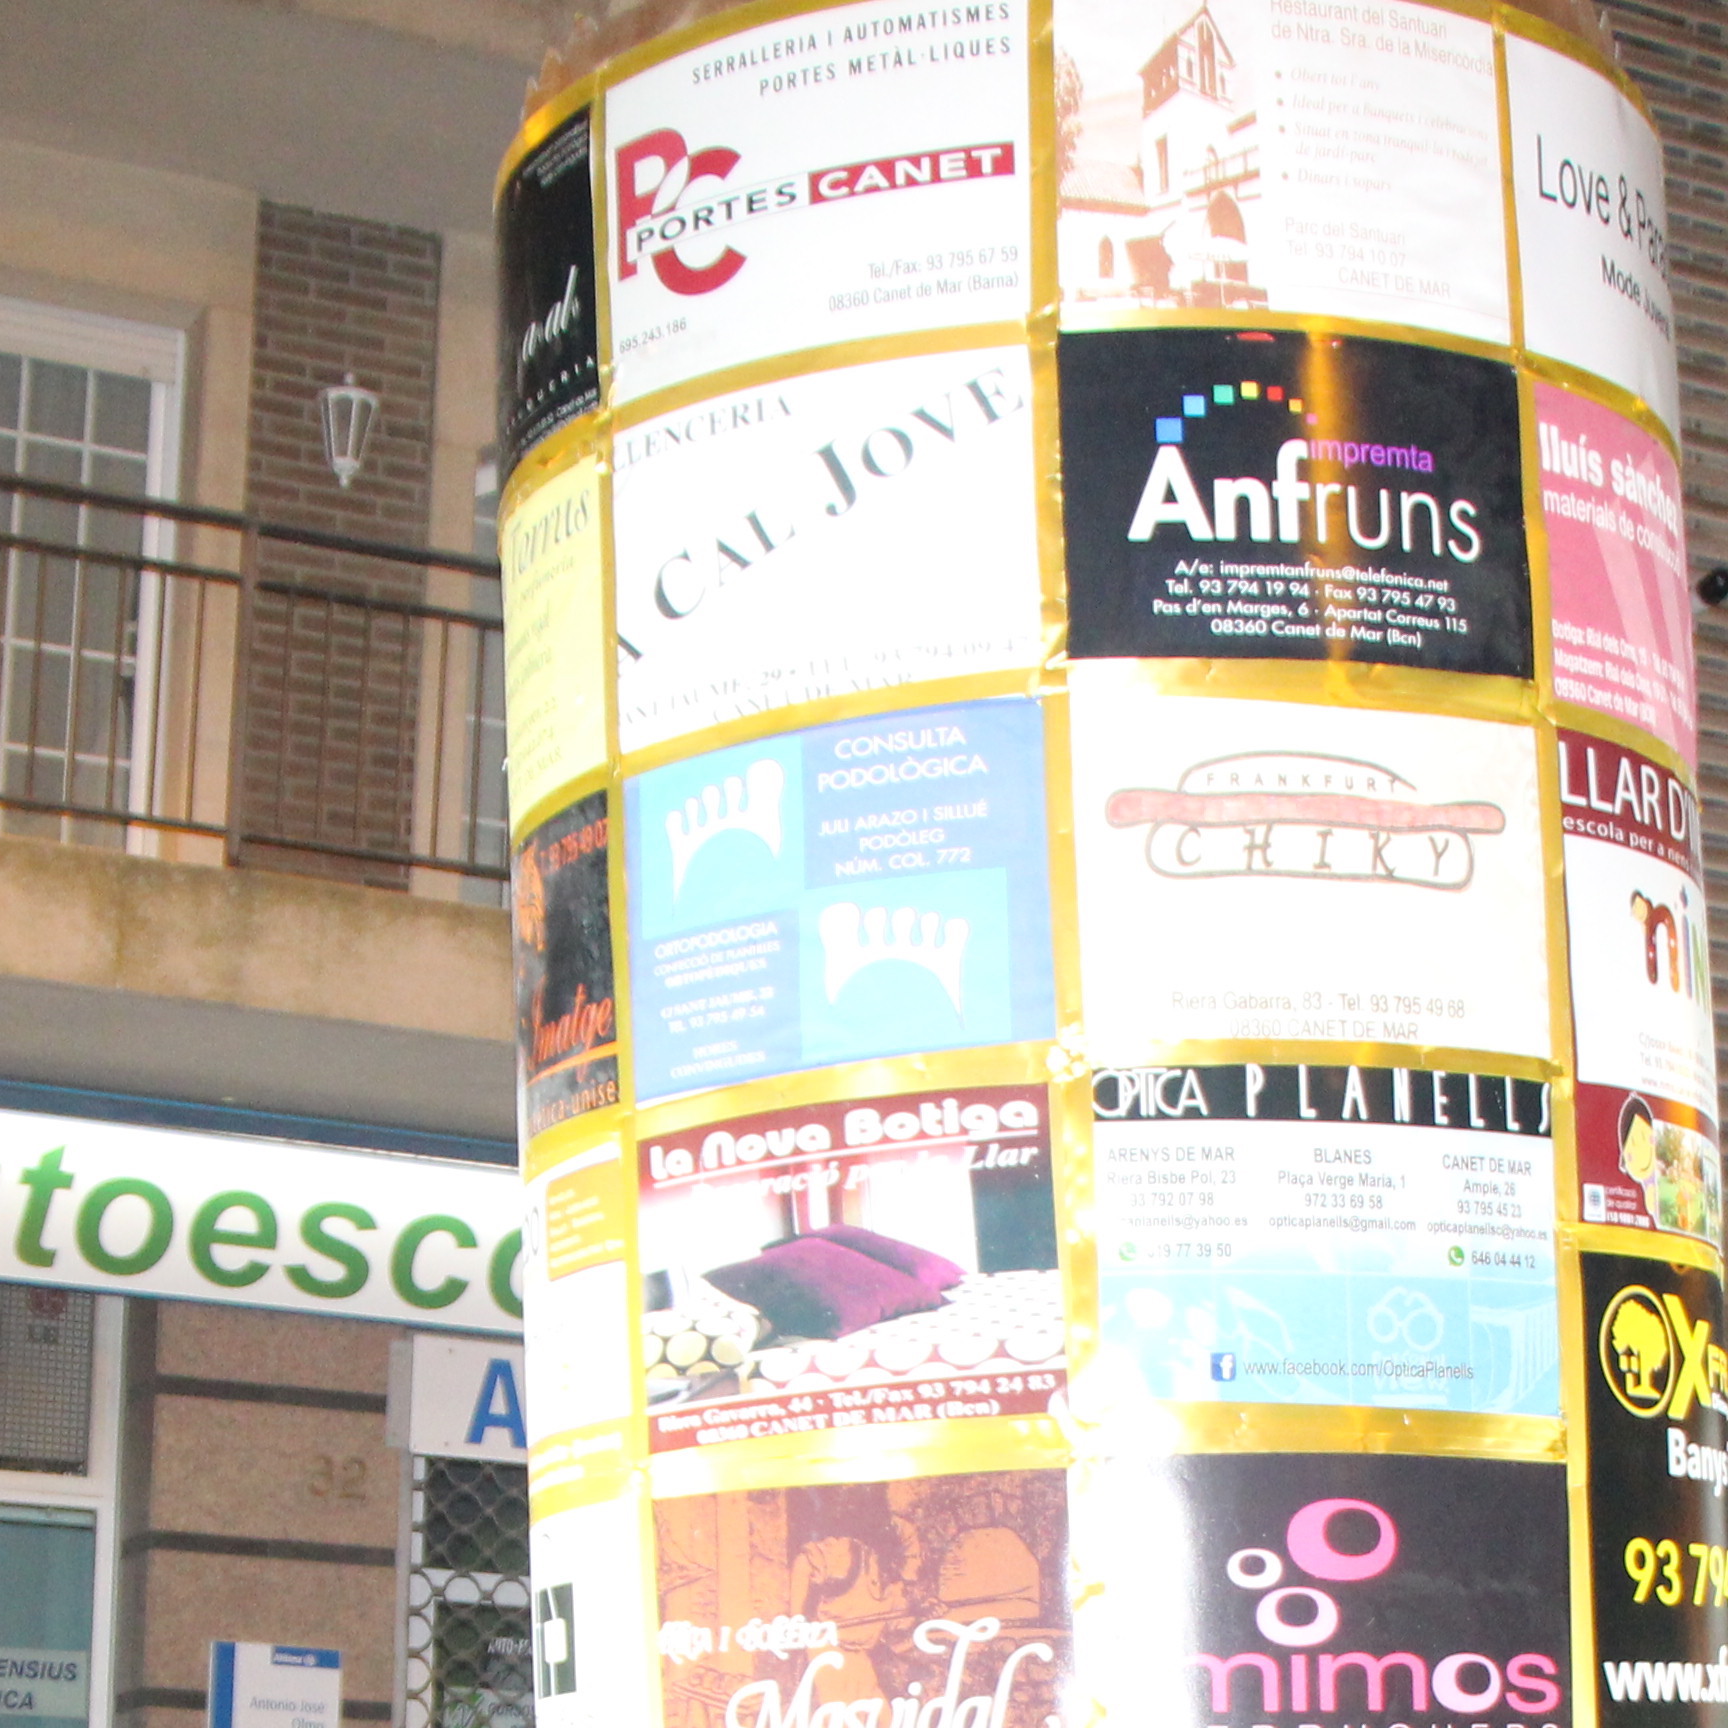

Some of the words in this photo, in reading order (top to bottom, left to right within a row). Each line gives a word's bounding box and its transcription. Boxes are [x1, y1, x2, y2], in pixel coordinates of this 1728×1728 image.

[1272, 20, 1292, 40] de
[1376, 34, 1394, 52] de
[1398, 37, 1412, 56] la
[1362, 8, 1384, 26] del
[1389, 10, 1448, 40] Santuari
[692, 31, 817, 85] SERRALLERIA
[843, 2, 1010, 44] AUTOMATISMES
[759, 62, 836, 96] PORTES
[1536, 133, 1610, 226] Love
[634, 181, 798, 253] PORTES
[817, 146, 1004, 201] CANET
[1285, 217, 1318, 237] Parc
[1323, 221, 1345, 239] del
[1349, 222, 1407, 247] Santuari
[927, 254, 944, 272] 93
[949, 251, 974, 270] 795
[979, 248, 996, 266] 67
[1001, 245, 1019, 263] 59
[828, 288, 870, 314] 08360
[873, 281, 913, 306] Canet
[916, 280, 933, 299] de
[937, 278, 963, 297] Mar
[968, 273, 1020, 294] (Barna)
[1338, 266, 1391, 290] CANET
[1394, 274, 1415, 294] DE
[1419, 278, 1452, 300] MAR
[1601, 253, 1641, 306] Mode
[619, 316, 688, 356] 695.243.186
[1308, 437, 1435, 475] impremta
[1538, 421, 1605, 488] lluís
[653, 507, 798, 620] CAL
[812, 366, 1026, 518] JOVE
[1127, 437, 1483, 564] Anfruns
[1542, 489, 1617, 534] materials
[1618, 511, 1635, 542] de
[1174, 559, 1214, 577] A/e:
[1219, 560, 1449, 593] impremtanfruns@telefonica.net
[1165, 579, 1193, 595] Tel.
[1198, 579, 1222, 594] 93
[1226, 579, 1260, 596] 794
[1265, 580, 1285, 597] 19
[1289, 581, 1311, 598] 94
[1324, 584, 1353, 601] Fax
[1356, 586, 1378, 602] 93
[1381, 588, 1412, 606] 795
[1414, 592, 1434, 610] 47
[1437, 595, 1457, 613] 93
[1152, 598, 1183, 615] Pas
[1226, 599, 1294, 619] Marges,
[1296, 601, 1310, 616] 6
[1324, 604, 1382, 624] Apartat
[1385, 607, 1441, 631] Correus
[1210, 618, 1268, 637] 08360
[1271, 620, 1322, 638] Canet
[1325, 622, 1346, 640] de
[1350, 626, 1383, 643] Mar
[1386, 628, 1423, 649] (Bcn)
[834, 726, 967, 761] CONSULTA
[817, 754, 990, 794] PODOLÒGICA
[1206, 772, 1400, 793] FRANKFURT
[1558, 739, 1664, 832] LLAR
[818, 817, 849, 837] JULI
[854, 808, 919, 832] ARAZO
[1562, 815, 1625, 842] escola
[1629, 831, 1654, 852] per
[888, 851, 931, 870] COL.
[936, 846, 972, 865] 772
[1175, 822, 1451, 880] CHIKY
[1171, 990, 1217, 1011] Riera
[1302, 990, 1322, 1012] 83
[1369, 994, 1389, 1015] 93
[1393, 995, 1423, 1017] 795
[1425, 997, 1446, 1018] 49
[1446, 998, 1467, 1020] 68
[1286, 1018, 1349, 1039] CANET
[1351, 1019, 1377, 1040] DE
[1382, 1021, 1420, 1041] MAR
[1245, 1062, 1553, 1136] PLANELLS
[650, 1144, 693, 1180] la
[700, 1123, 831, 1170] Nova
[843, 1098, 1039, 1150] Botiga
[1107, 1146, 1171, 1163] ARENYS
[1175, 1146, 1196, 1162] DE
[1201, 1145, 1236, 1162] MAR
[965, 1143, 1040, 1171] Llar
[1313, 1148, 1373, 1166] BLANES
[1442, 1154, 1485, 1172] CANET
[1488, 1157, 1505, 1174] DE
[1507, 1159, 1532, 1176] MAR
[1147, 1170, 1187, 1186] Bisbe
[1220, 1170, 1237, 1185] 23
[1278, 1170, 1314, 1188] Plaça
[1317, 1171, 1355, 1190] Verge
[1150, 1191, 1175, 1207] 792
[1179, 1191, 1195, 1207] 07
[1198, 1191, 1215, 1206] 98
[1304, 1193, 1327, 1208] 972
[1330, 1193, 1347, 1208] 33
[1349, 1194, 1365, 1209] 69
[1368, 1194, 1384, 1210] 58
[1457, 1199, 1471, 1216] 93
[1474, 1200, 1494, 1216] 795
[1268, 1215, 1417, 1234] opticaplanells@gmail.com
[1472, 1250, 1491, 1266] 646
[1524, 1254, 1536, 1269] 12
[1243, 1359, 1474, 1380] www.facebook.com/OpticaPlanells
[751, 1414, 829, 1437] CANET
[832, 1410, 867, 1429] DE
[874, 1404, 933, 1423] MAR
[936, 1398, 1000, 1420] (Bcn)
[307, 1453, 368, 1501] 32
[1623, 1537, 1683, 1607] 93
[1186, 1652, 1562, 1716] mimos
[249, 1696, 296, 1713] Antonio
